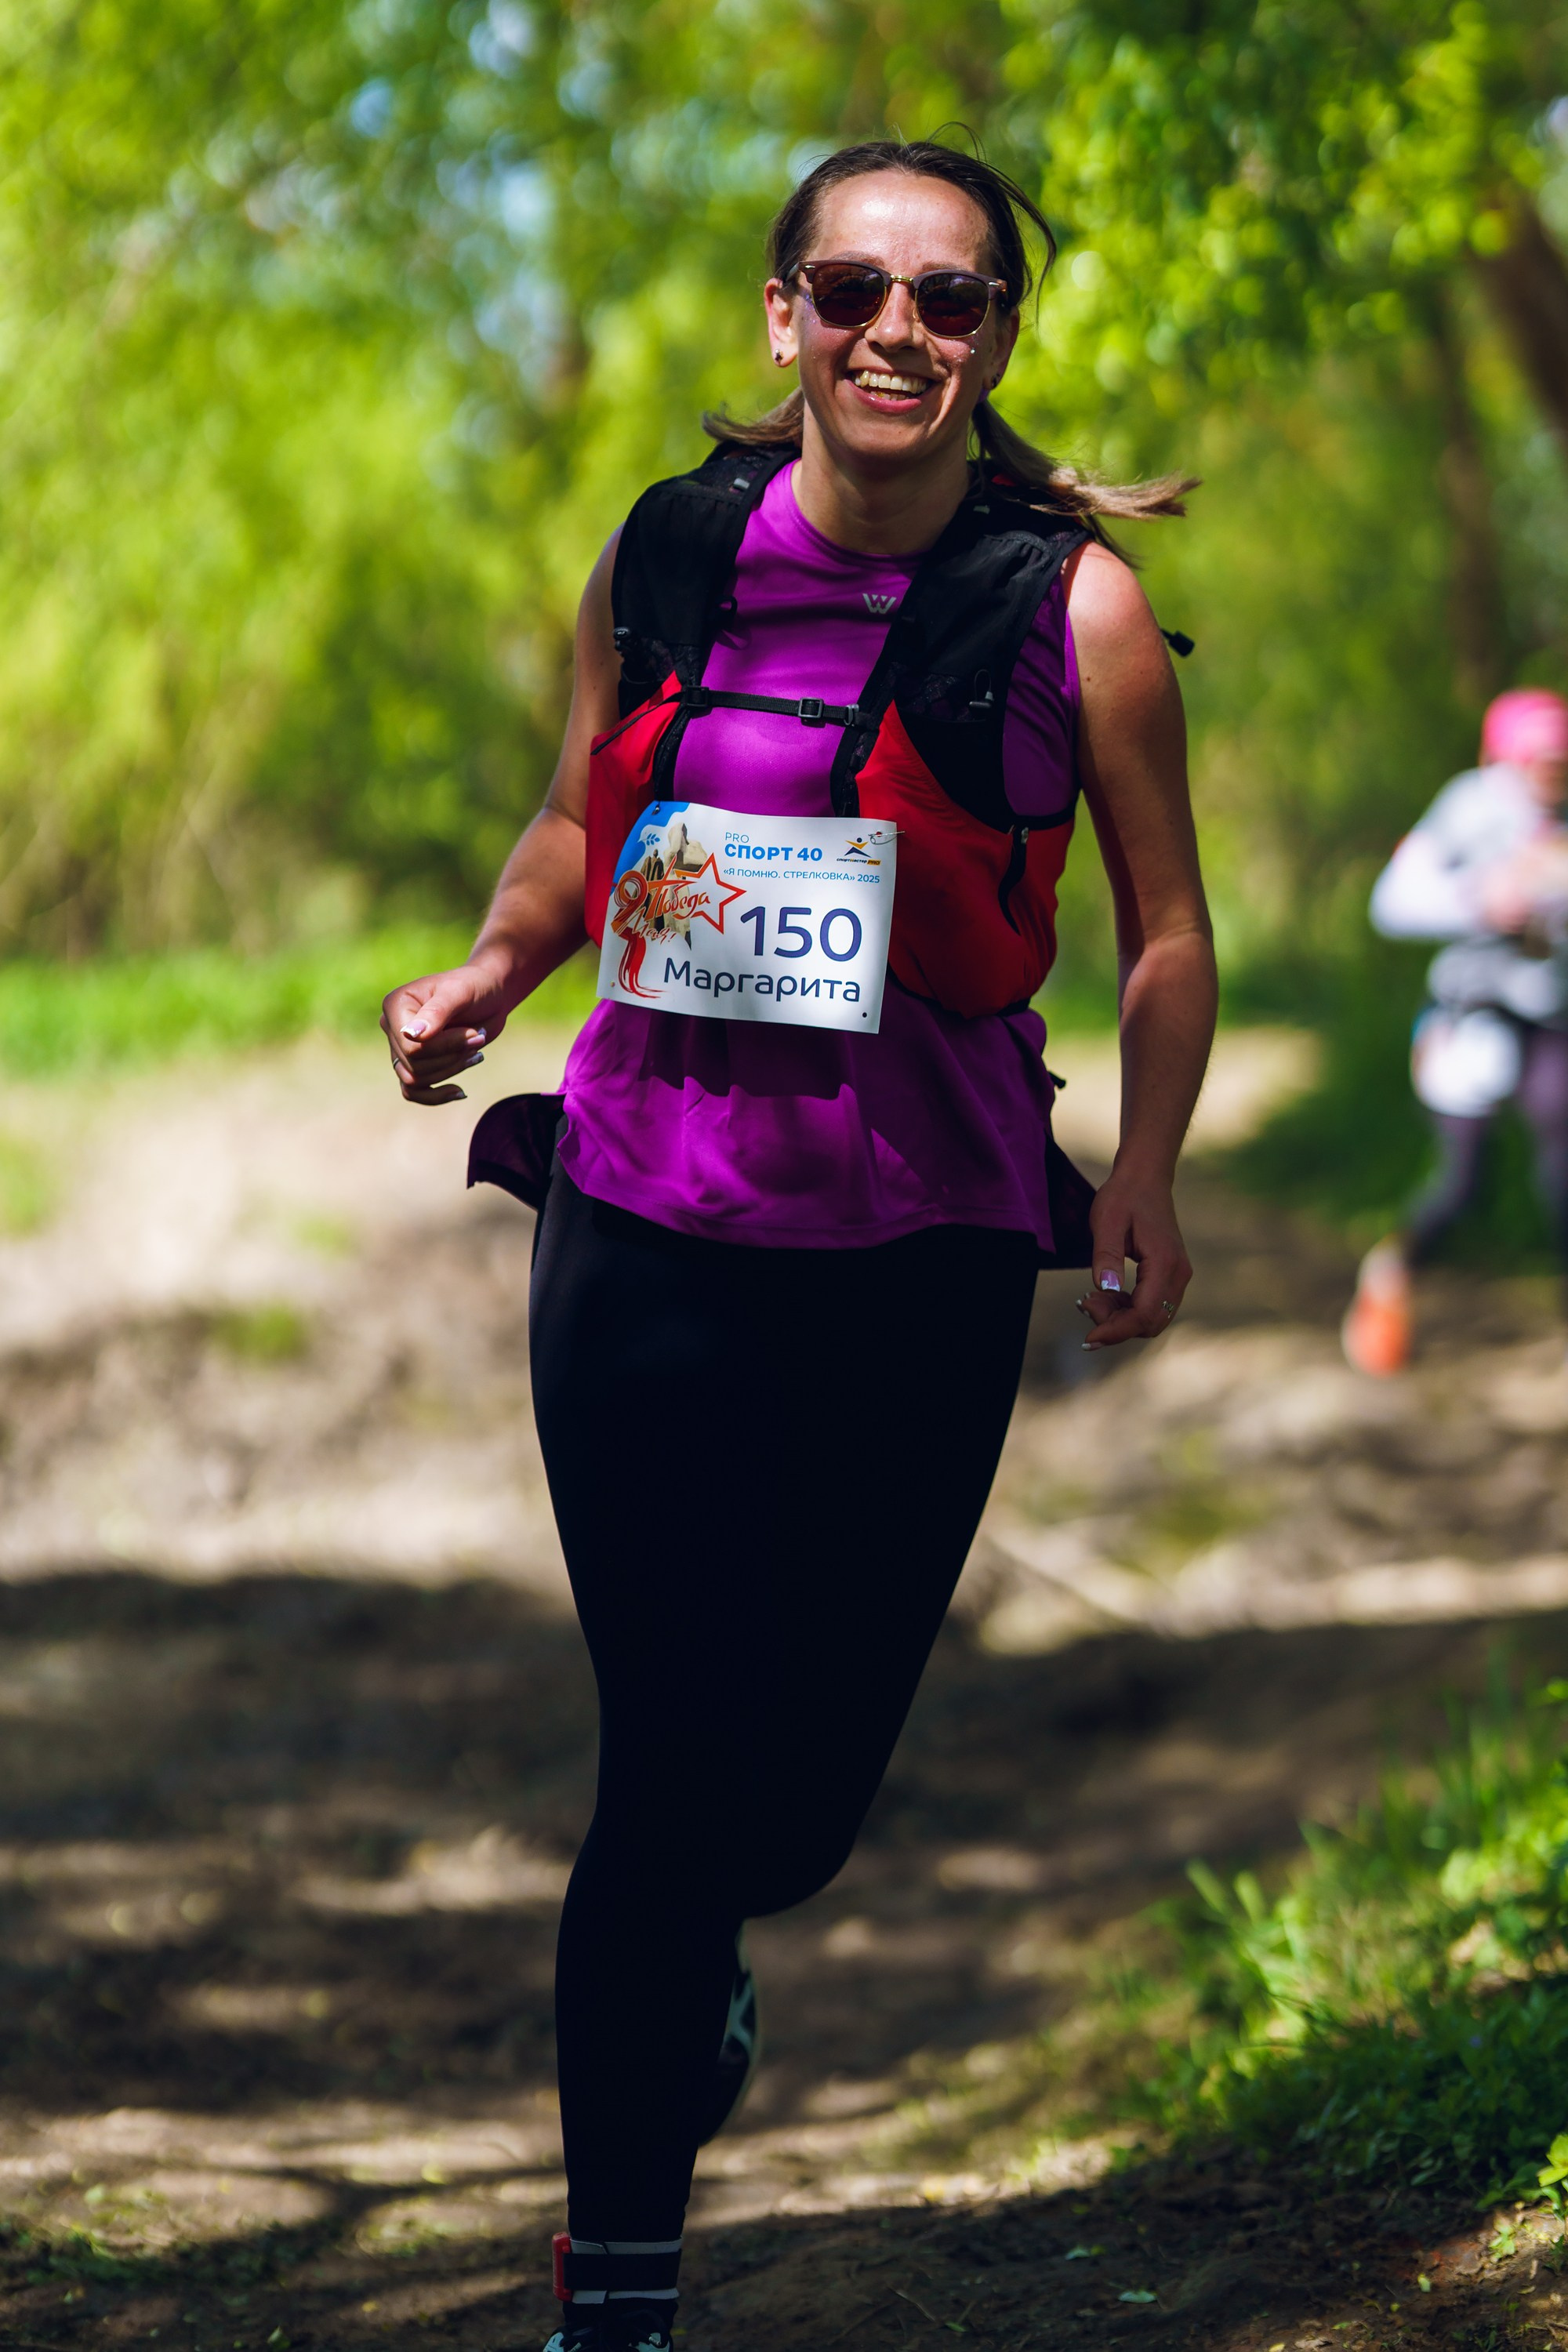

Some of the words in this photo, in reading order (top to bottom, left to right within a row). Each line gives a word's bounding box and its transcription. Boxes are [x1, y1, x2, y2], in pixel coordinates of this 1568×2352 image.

[725, 832, 750, 844] PRO
[724, 844, 793, 862] СПОРТ
[797, 848, 823, 862] 40
[737, 869, 781, 879] ПОМНЮ.
[783, 871, 855, 881] СТРЕЛКОВКА»
[857, 873, 880, 884] 2025
[740, 906, 862, 962] 150
[663, 957, 861, 1003] Маргарита
